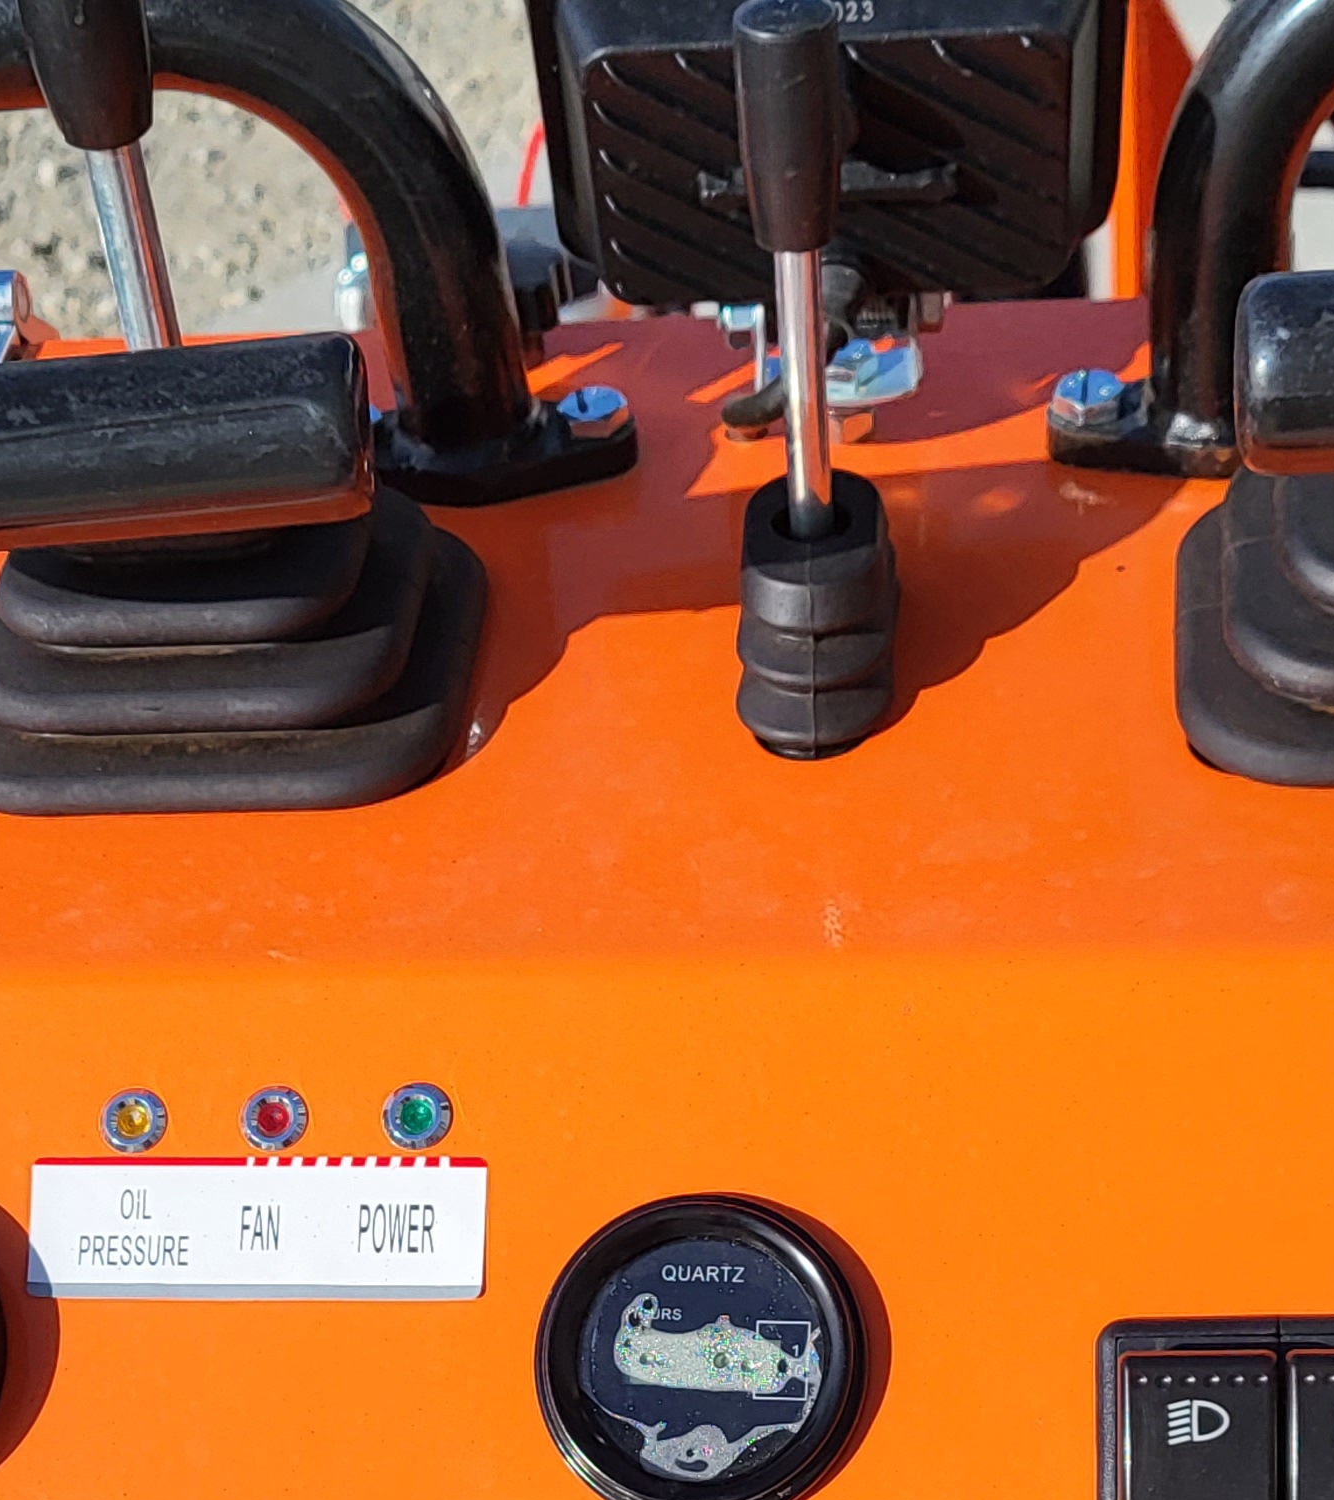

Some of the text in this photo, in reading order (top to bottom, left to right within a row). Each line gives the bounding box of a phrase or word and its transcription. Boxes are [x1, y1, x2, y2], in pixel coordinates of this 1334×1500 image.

[120, 1188, 152, 1220] OIL
[240, 1204, 280, 1251] FAN
[358, 1204, 435, 1254] POWER
[78, 1235, 190, 1267] PRESSURE
[661, 1264, 746, 1284] QUARTZ
